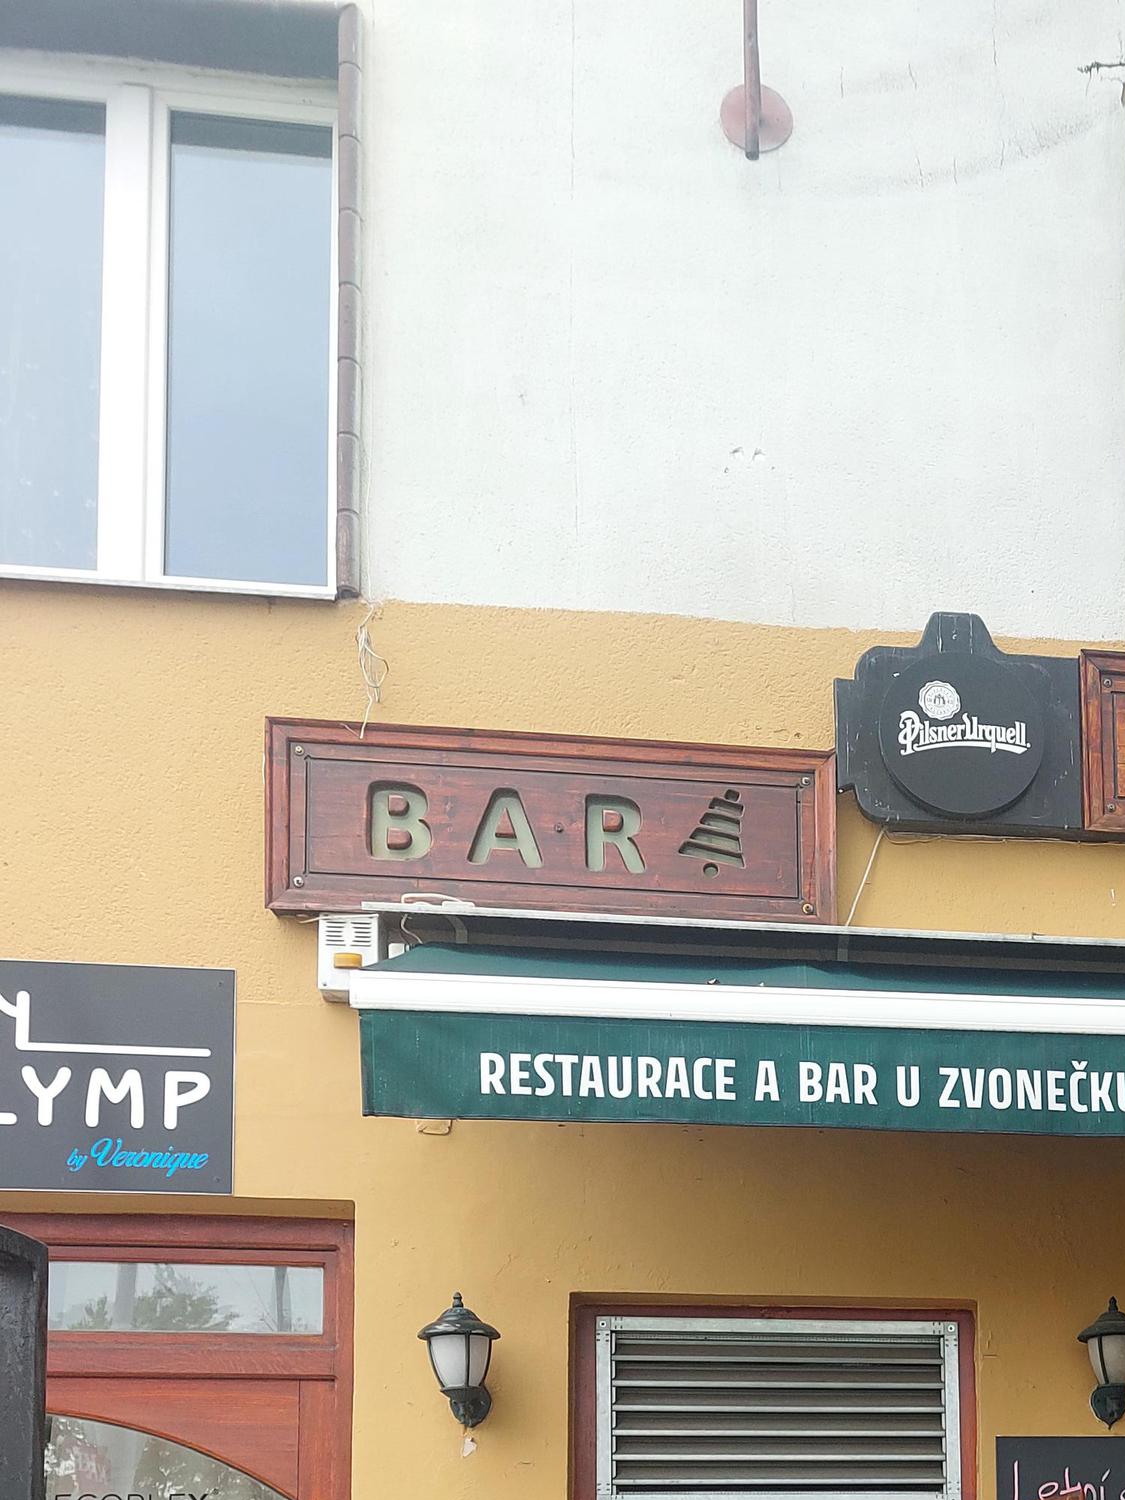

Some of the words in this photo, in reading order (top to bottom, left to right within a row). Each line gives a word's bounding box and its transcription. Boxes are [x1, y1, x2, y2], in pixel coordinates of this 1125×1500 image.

[898, 710, 965, 756] Pilsner
[365, 779, 646, 876] BAR
[480, 1052, 734, 1102] RESTAURACE
[755, 1061, 780, 1102] A
[799, 1061, 879, 1106] BAR
[895, 1068, 921, 1108] U
[66, 1147, 88, 1172] by
[90, 1137, 209, 1178] Veronique
